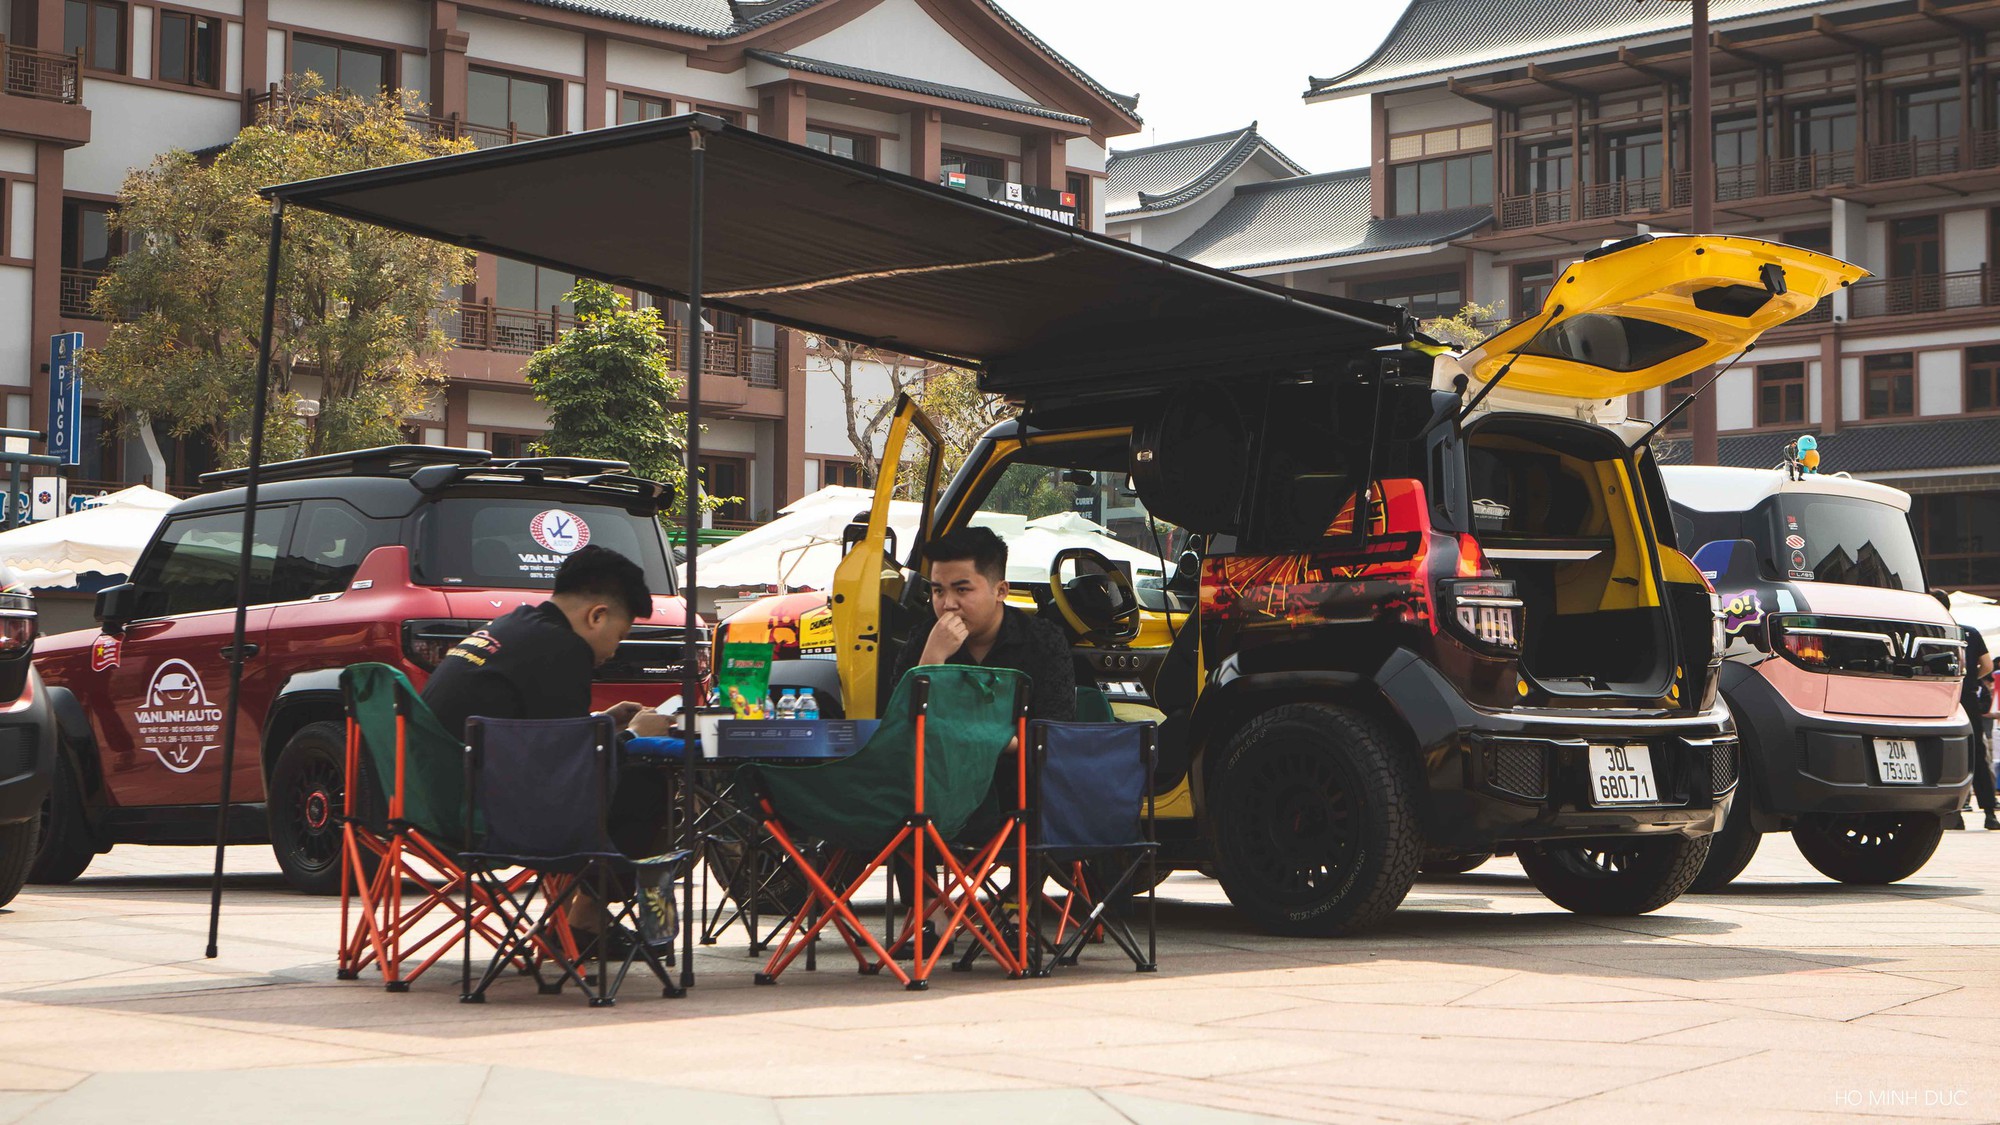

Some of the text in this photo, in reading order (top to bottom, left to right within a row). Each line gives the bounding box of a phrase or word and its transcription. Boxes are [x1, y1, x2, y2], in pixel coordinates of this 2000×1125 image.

[55, 364, 66, 447] BINGO
[1075, 497, 1094, 505] CURRY
[1605, 747, 1635, 772] 30L
[1886, 741, 1907, 760] 20A
[1882, 761, 1918, 780] 753.09
[1600, 774, 1650, 799] 680.71
